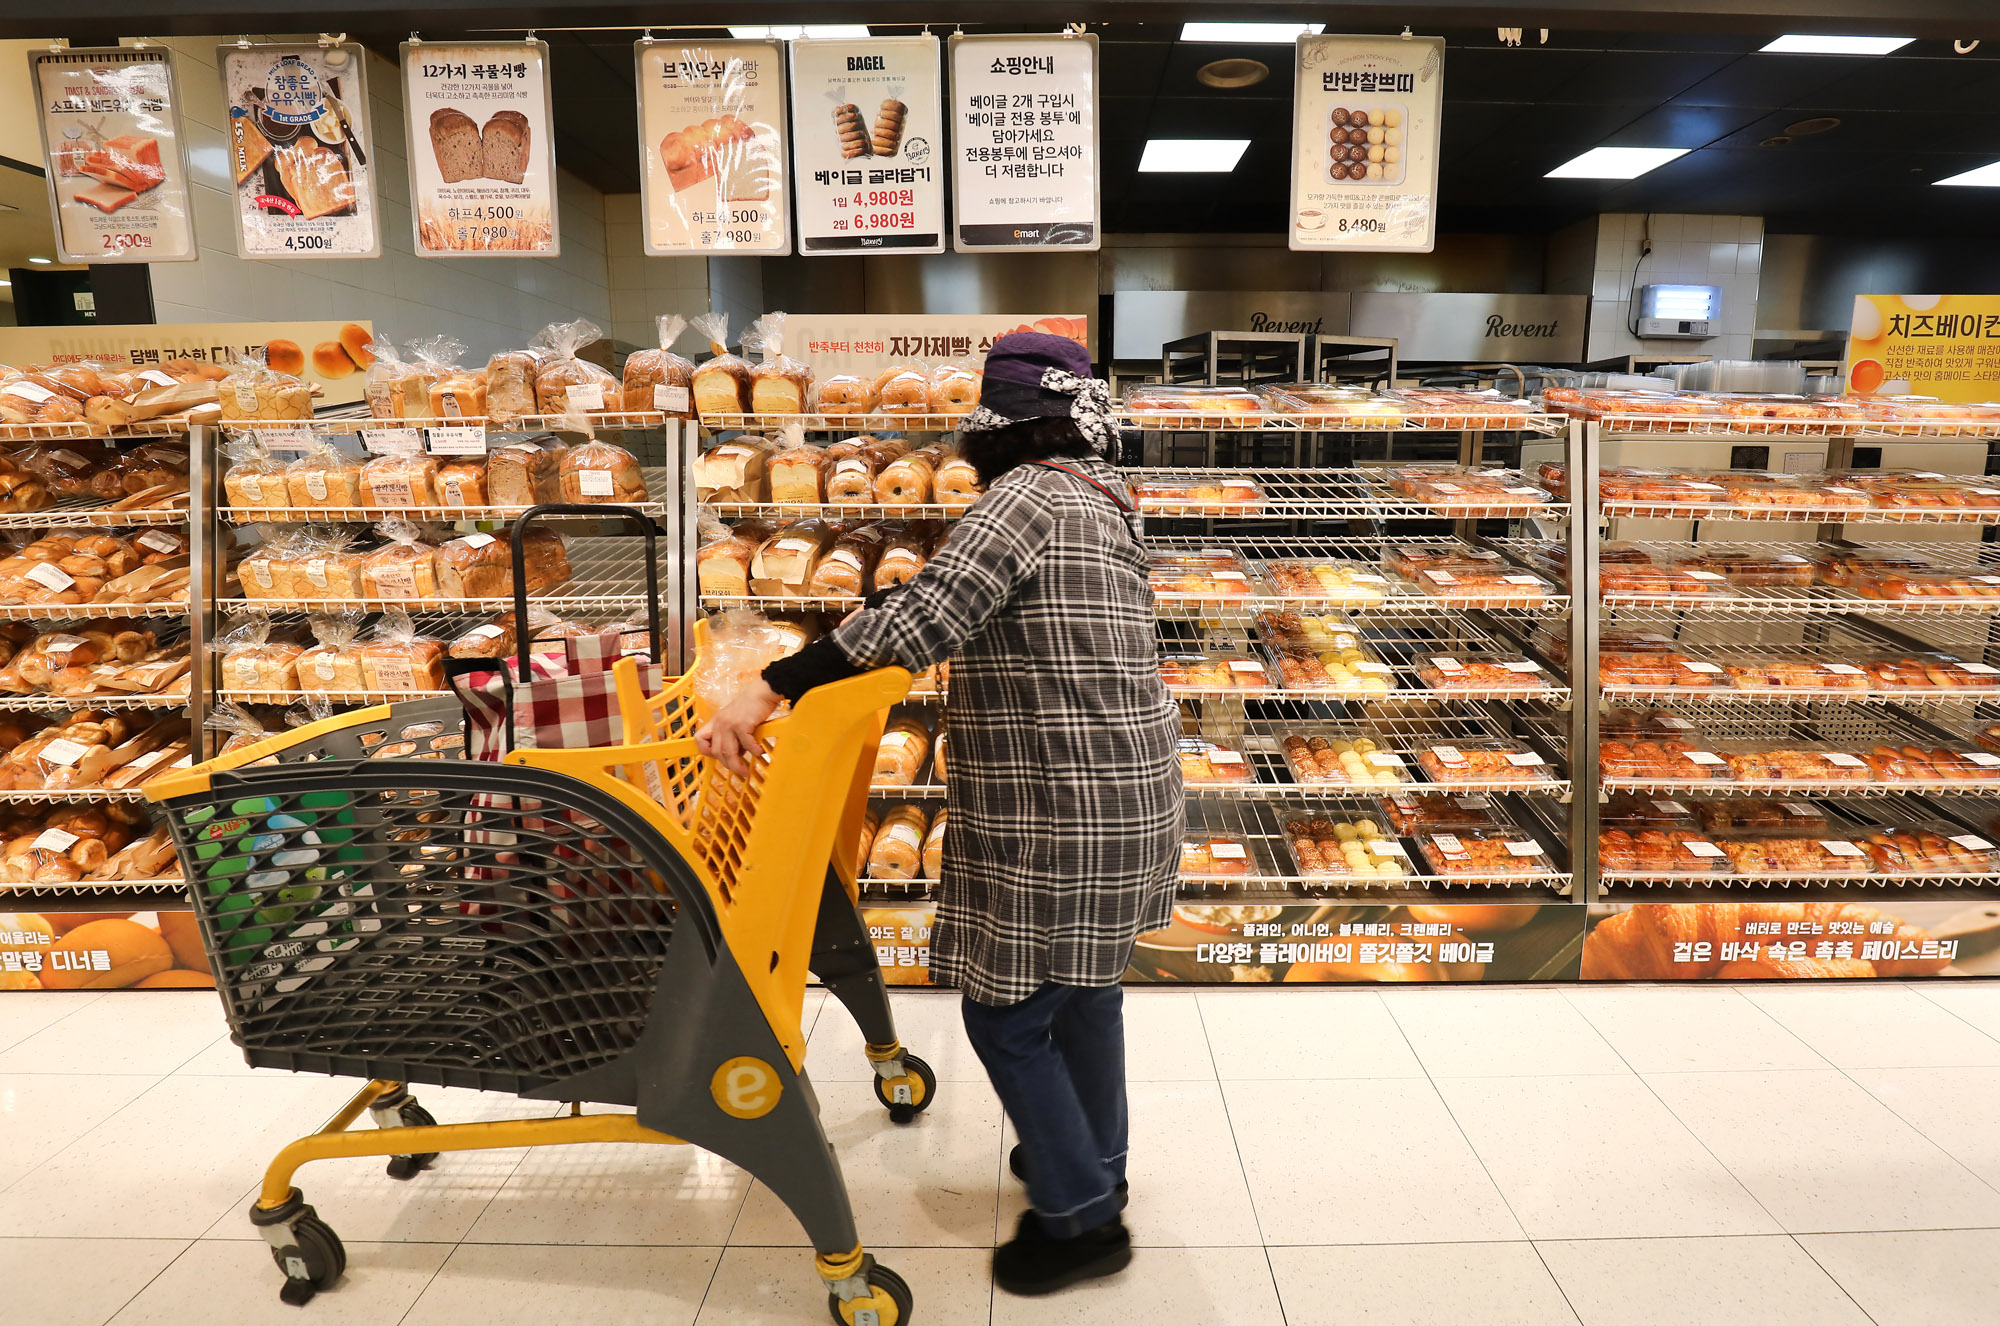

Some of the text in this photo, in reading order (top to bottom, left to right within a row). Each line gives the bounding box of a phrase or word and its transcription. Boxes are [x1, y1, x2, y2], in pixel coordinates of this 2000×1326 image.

[268, 63, 281, 76] MILK
[296, 60, 315, 76] BREAD
[423, 62, 527, 79] 12가지 곡물식빵
[662, 60, 759, 80] 브리오쉬 빵
[847, 56, 885, 71] BAGEL
[990, 55, 1054, 75] 쇼핑안내
[274, 75, 310, 91] 참좋은
[441, 83, 459, 91] 건강한
[461, 83, 480, 91] 12가지
[1323, 72, 1414, 93] 반반찰쁘띠
[64, 86, 83, 96] TOAST
[271, 92, 317, 106] 우유식빵
[446, 91, 471, 99] 고소하고
[472, 91, 490, 99] 촉촉한
[516, 91, 528, 99] 식빵
[51, 100, 87, 113] 소프트
[91, 98, 132, 113] 샌드위
[970, 93, 1074, 109] 베이글 2개 구입시
[279, 114, 313, 122] 1st GRADE
[1010, 111, 1035, 126] 전용
[992, 128, 1055, 144] 담아가세요
[234, 121, 248, 173] 15% MILK
[966, 145, 1082, 162] 전용봉투에 담으셔야
[814, 166, 931, 186] 베이글 골라담기
[985, 163, 1064, 179] 더 저렴합니다
[832, 189, 914, 208] 1입 4,980원
[1008, 197, 1038, 205] 참고하시기
[832, 212, 915, 230] 2입 6,980원
[1338, 218, 1386, 233] 8,480원
[1014, 229, 1040, 239] emart
[285, 236, 332, 251] 4,500원
[1250, 311, 1323, 334] Revent
[1485, 314, 1559, 338] Revent
[809, 336, 972, 357] 반죽부터 천천히 자가제빵
[1886, 345, 1975, 355] 신선한 재료를 사용해
[53, 353, 82, 363] 어디에도
[130, 349, 159, 364] 담백
[1885, 358, 1903, 368] 직접
[1906, 358, 1942, 368] 반죽하여
[1945, 358, 1973, 368] 맛있게
[1884, 371, 1911, 381] 고소한
[1913, 371, 1932, 381] 맛의
[1934, 371, 1971, 381] 홈메이드
[901, 926, 914, 940] 잘
[1243, 923, 1452, 937] 플레인, 어니언, 블루베리, 크랜베리
[1745, 922, 1895, 935] 버터로 만드는 맛있는 예술
[0, 932, 50, 945] 어울리는
[1196, 942, 1495, 964] 다양한 플레이버의 쫄깃쫄깃 베이글
[1719, 940, 1760, 962] 바삭
[1767, 940, 1808, 962] 속은
[1814, 940, 1854, 962] 촉촉
[1861, 940, 1959, 962] 페이스트리
[0, 950, 111, 971] 말랑 디너롤
[726, 1066, 767, 1110] e
